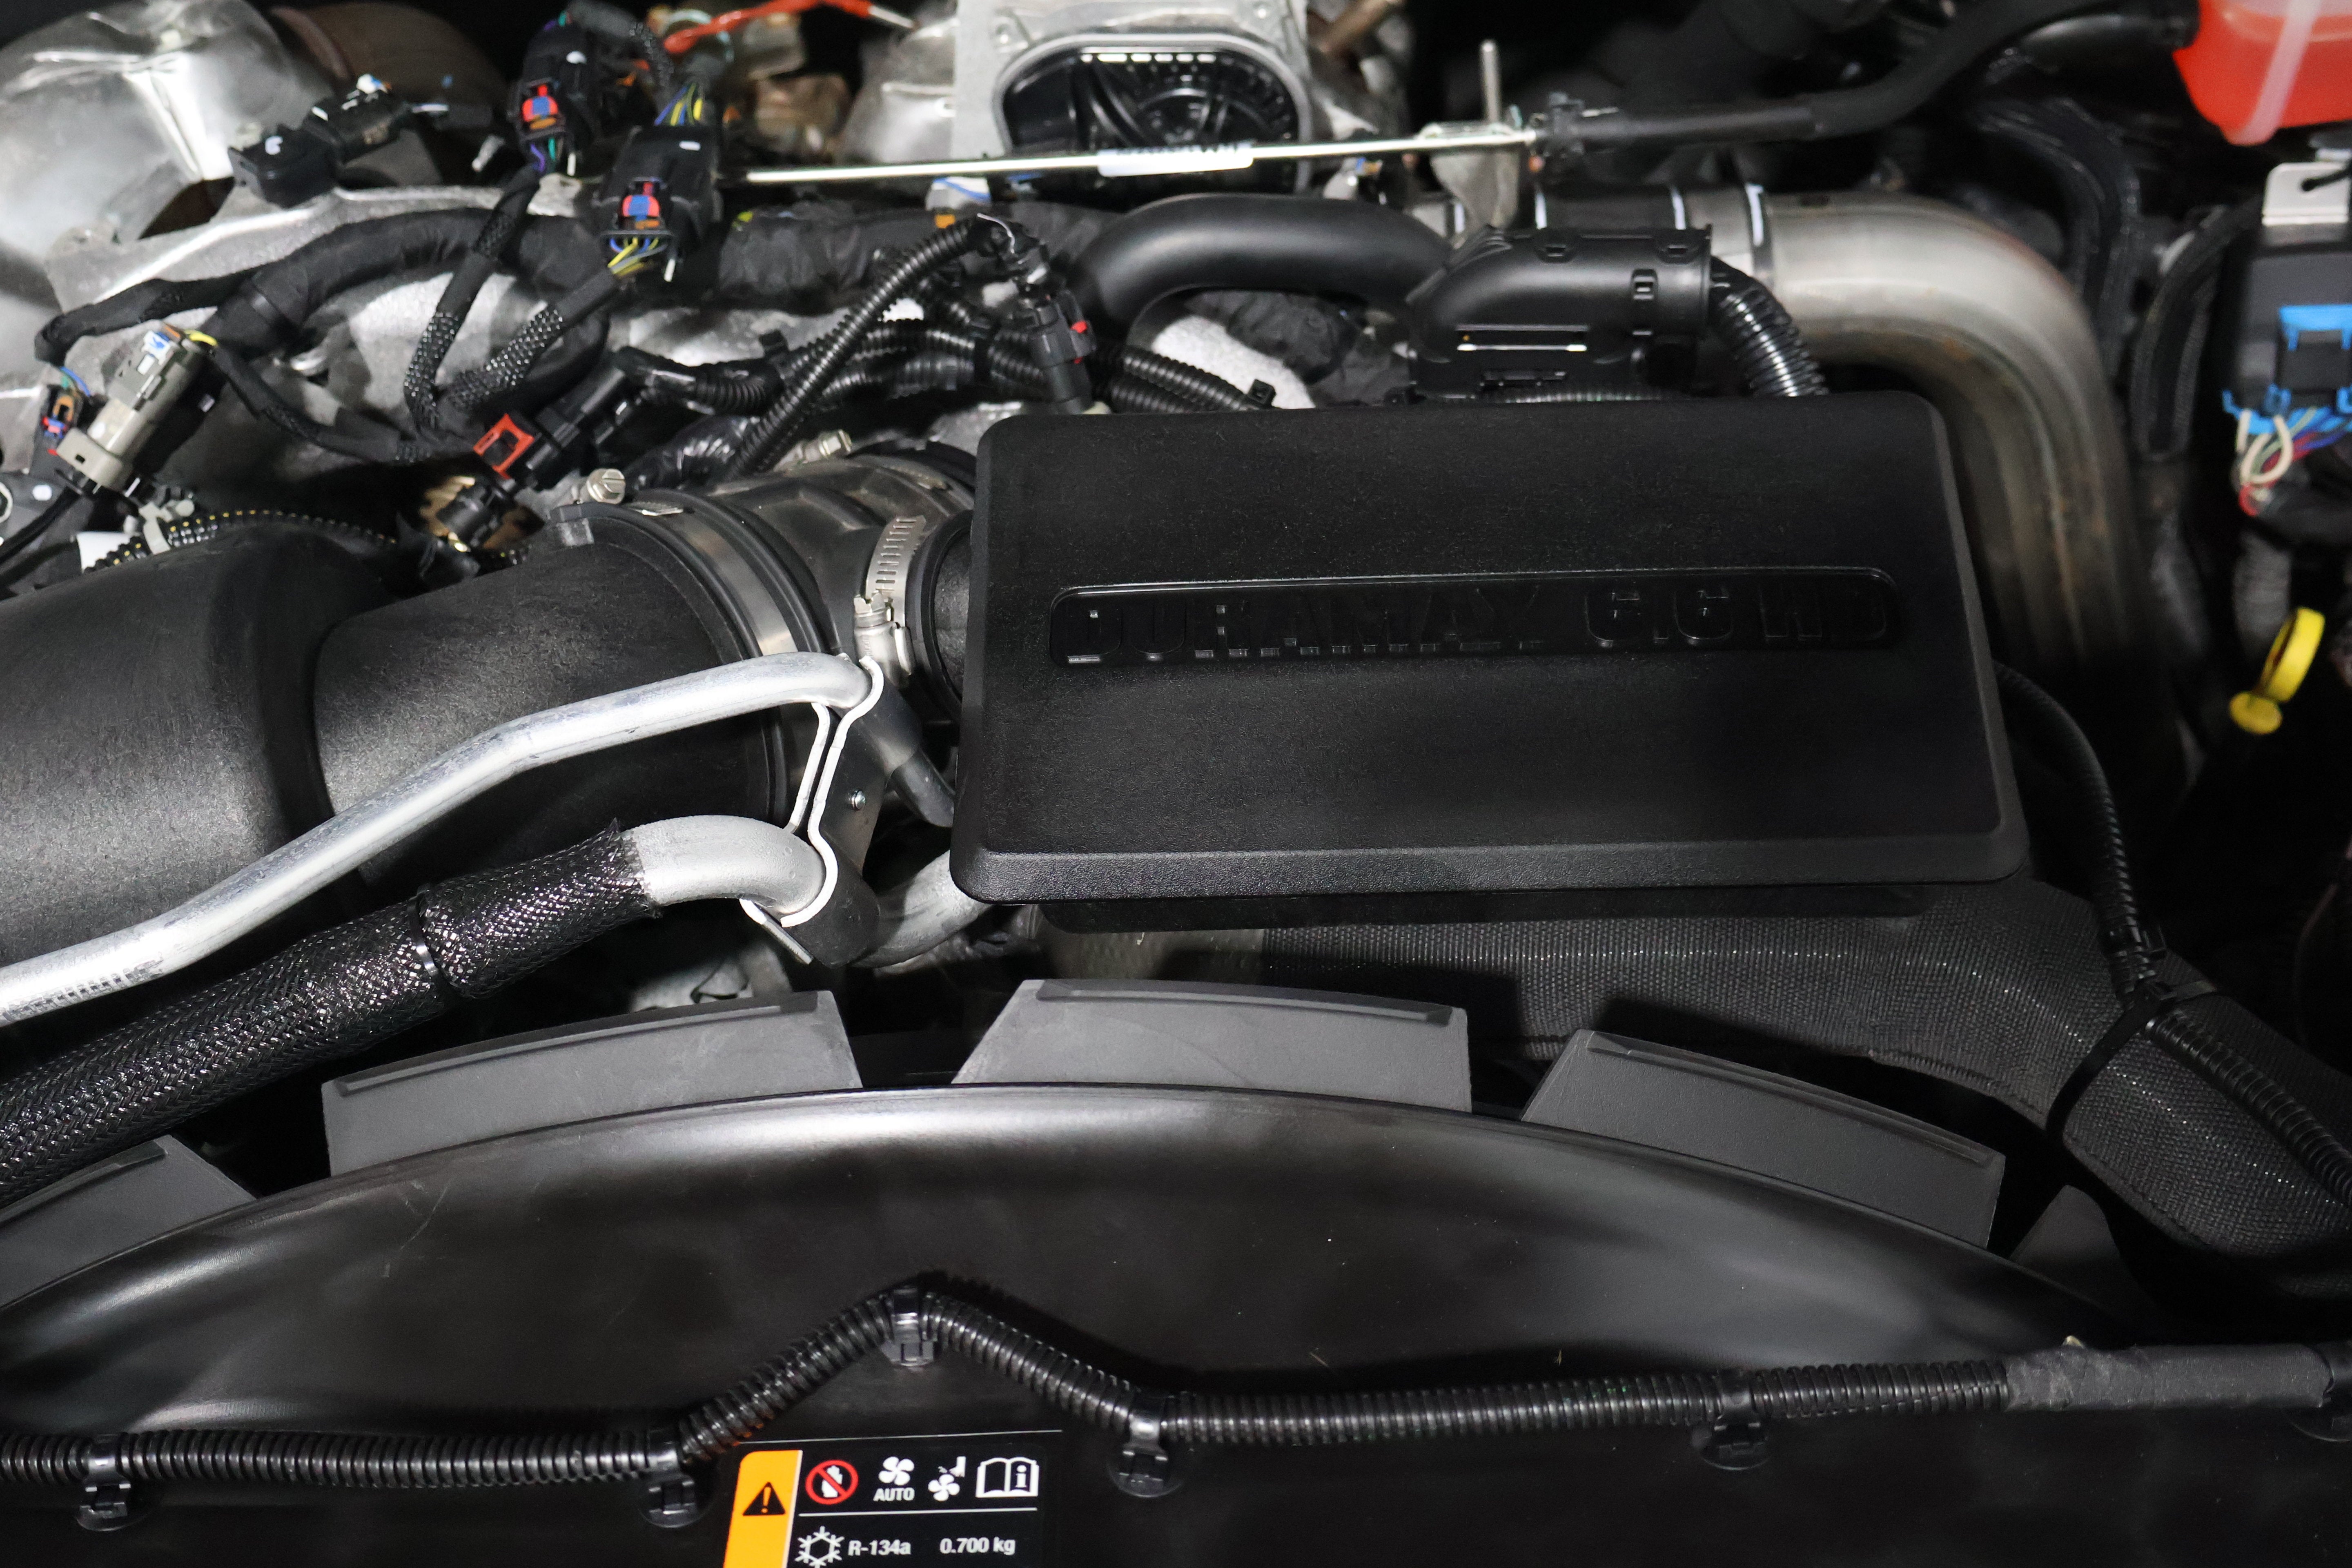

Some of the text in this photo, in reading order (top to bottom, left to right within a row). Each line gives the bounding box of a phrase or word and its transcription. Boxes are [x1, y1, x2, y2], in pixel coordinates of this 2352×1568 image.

[1064, 585, 1547, 663] DURAMAX
[873, 1487, 915, 1501] AUTO
[848, 1537, 1016, 1556] R-134a 0.700 kg
